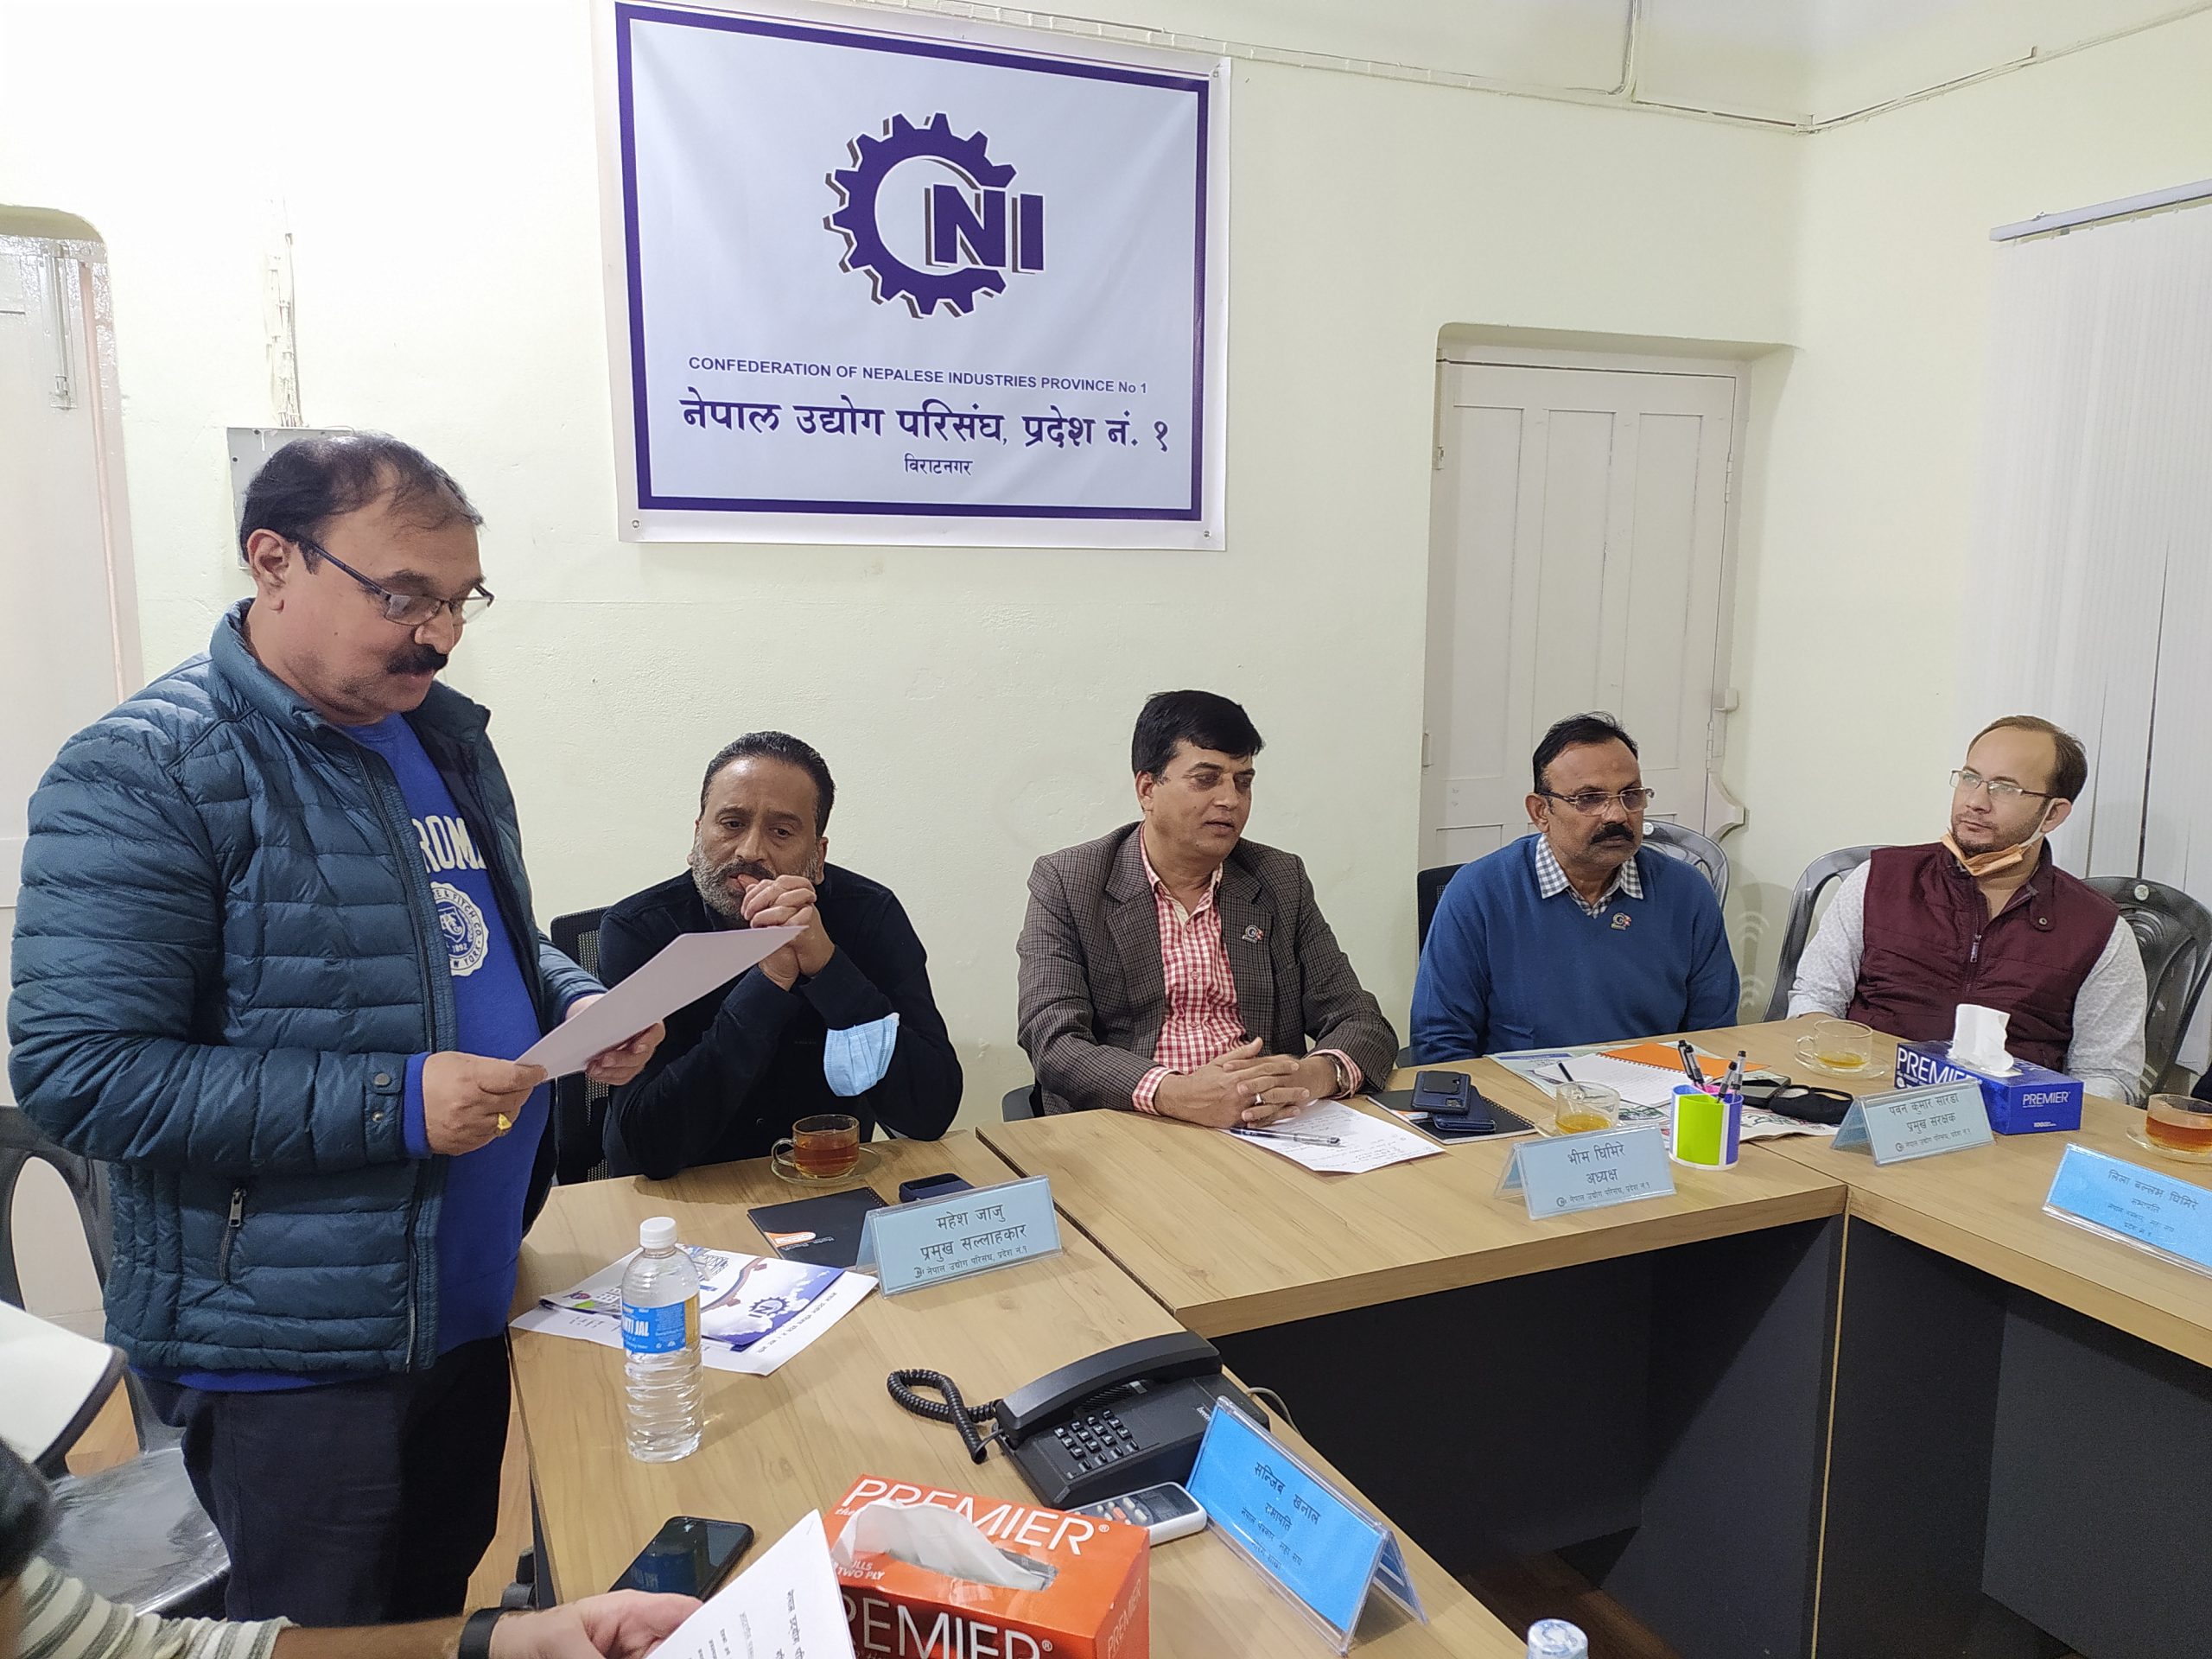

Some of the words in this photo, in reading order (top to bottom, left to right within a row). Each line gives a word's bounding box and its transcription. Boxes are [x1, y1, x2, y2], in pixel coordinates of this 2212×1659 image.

[689, 356, 830, 378] CONFEDERATION
[836, 365, 857, 378] OF
[862, 367, 944, 383] NEPALESE
[949, 371, 1037, 388] INDUSTRIES
[1040, 377, 1115, 393] PROVINCE
[1118, 381, 1136, 393] No
[1141, 383, 1147, 394] 1
[678, 386, 782, 433] नेपाल
[792, 394, 887, 435] उद्योग
[895, 398, 1007, 445] परिसंघ,
[1021, 404, 1096, 448] प्रदेश
[1105, 410, 1139, 447] नं.
[1154, 420, 1168, 452] १
[905, 453, 973, 475] विराटनगर
[1910, 1098, 1932, 1115] कुमार
[2022, 1091, 2069, 1105] PREMIER
[1906, 1119, 1927, 1134] प्रमुख
[1567, 1149, 1591, 1166] भीम
[1593, 1141, 1626, 1160] घिमिरे
[1586, 1168, 1618, 1185] अध्यक्ष
[935, 1211, 969, 1230] महेश
[975, 1204, 1006, 1223] जाजु
[919, 1241, 954, 1262] प्रमुख
[960, 1224, 1027, 1251] सल्लाहकार
[926, 1266, 946, 1275] नेपाल
[950, 1258, 969, 1271] उद्योग
[997, 1248, 1013, 1258] प्रदेश
[1255, 1462, 1286, 1495] सन्जिब
[1293, 1494, 1321, 1525] खनाल
[865, 1571, 886, 1580] PLY
